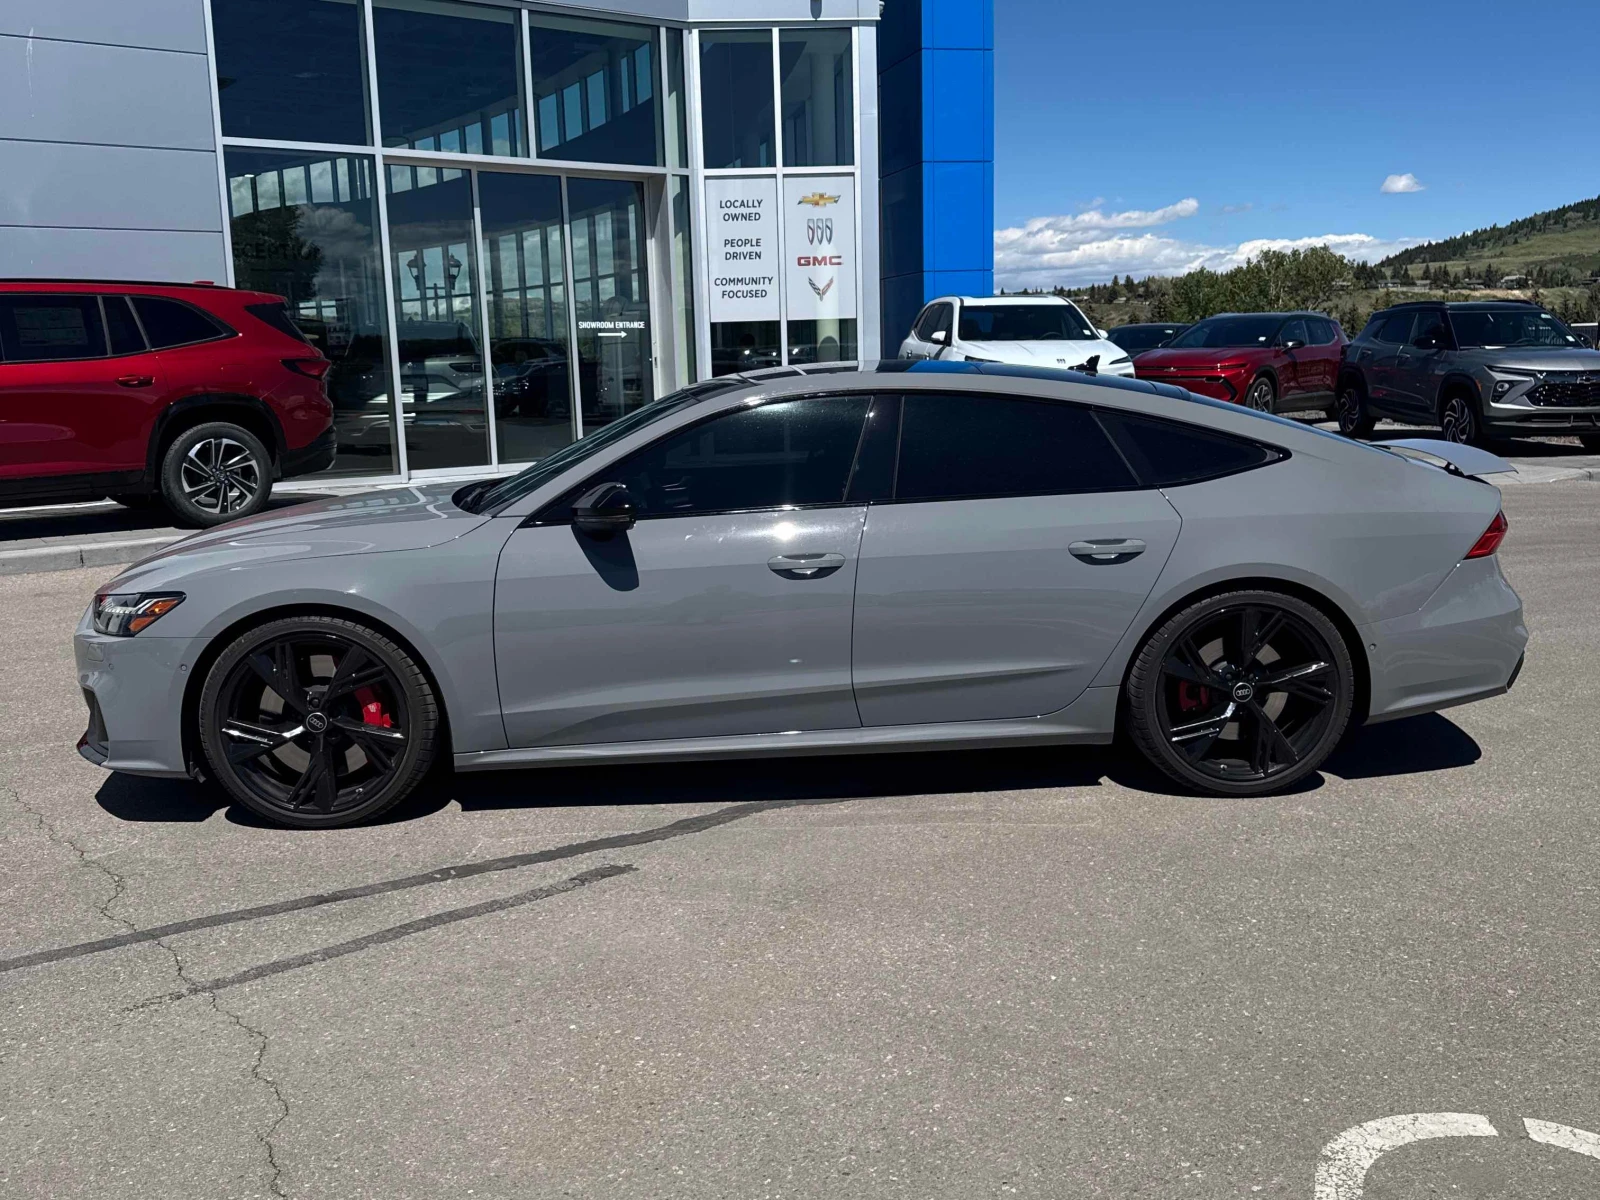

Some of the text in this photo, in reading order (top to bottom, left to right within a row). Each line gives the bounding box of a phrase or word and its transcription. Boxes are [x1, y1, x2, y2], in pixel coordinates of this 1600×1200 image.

[719, 199, 763, 209] LOCALLY
[723, 212, 761, 222] OWNED
[724, 238, 762, 248] PEOPLE
[725, 251, 762, 261] DRIVEN
[797, 255, 842, 267] GMC
[714, 276, 774, 287] COMMUNITY
[721, 289, 768, 299] FOCUSED
[578, 321, 646, 329] SHOWROOM ENTRANCE
